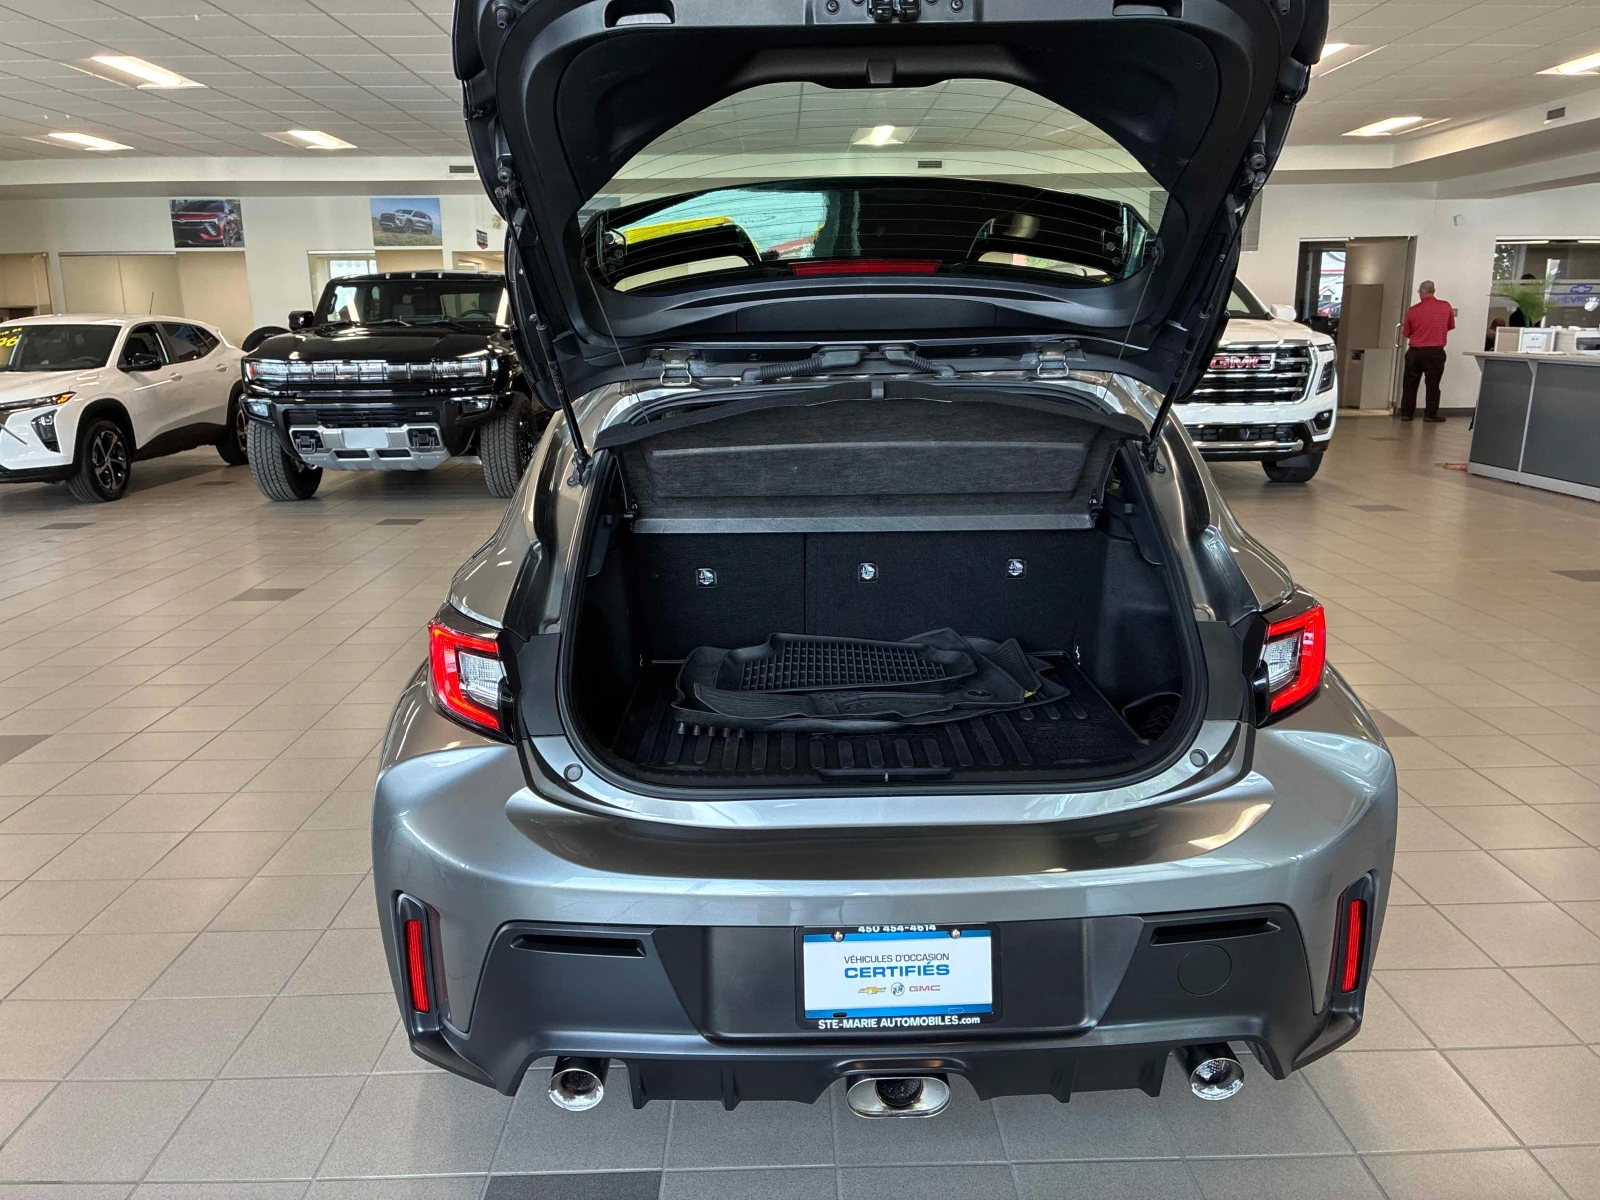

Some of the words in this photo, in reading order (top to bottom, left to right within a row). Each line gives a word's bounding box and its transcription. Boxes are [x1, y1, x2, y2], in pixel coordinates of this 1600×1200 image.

[1210, 355, 1271, 369] GMC
[858, 925, 880, 933] 450
[883, 924, 937, 933] 454-4614
[843, 954, 893, 964] VÉHICULES
[895, 952, 950, 963] D'OCCASION
[844, 962, 950, 979] CERTIFIÉS
[818, 1018, 878, 1029] STE-MARIE
[879, 1015, 981, 1028] AUTOMOBILES.com
